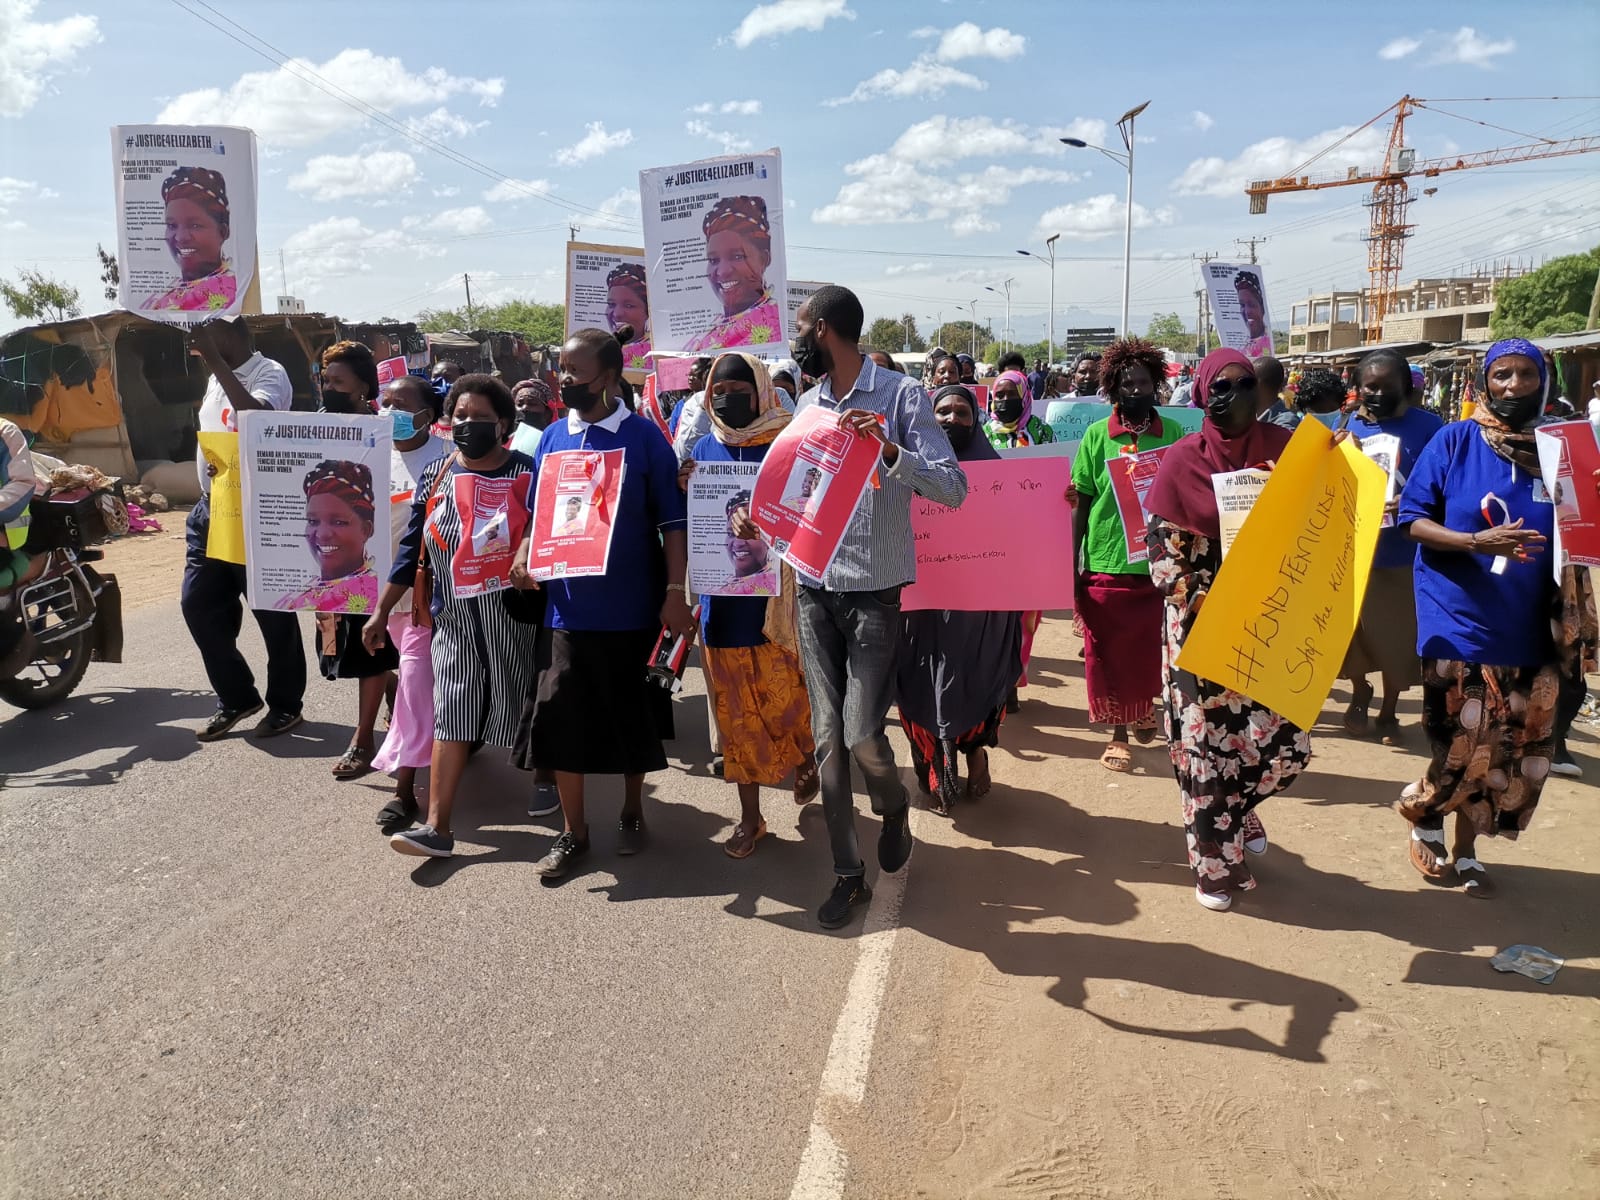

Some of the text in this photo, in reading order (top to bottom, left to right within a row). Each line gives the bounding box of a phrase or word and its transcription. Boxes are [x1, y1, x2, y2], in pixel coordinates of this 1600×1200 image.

[125, 134, 212, 148] #JUSTICE4ELIZABETH
[664, 162, 754, 188] #JUSTICE4ELIZABETH
[264, 425, 362, 440] #JUSTICE4ELIZABETH
[699, 465, 760, 475] #JUSTICE4ELIZAB
[991, 480, 1005, 496] for
[1285, 636, 1324, 694] Stop
[1313, 604, 1333, 633] the
[1328, 532, 1353, 593] Killings
[1226, 586, 1289, 690] #END
